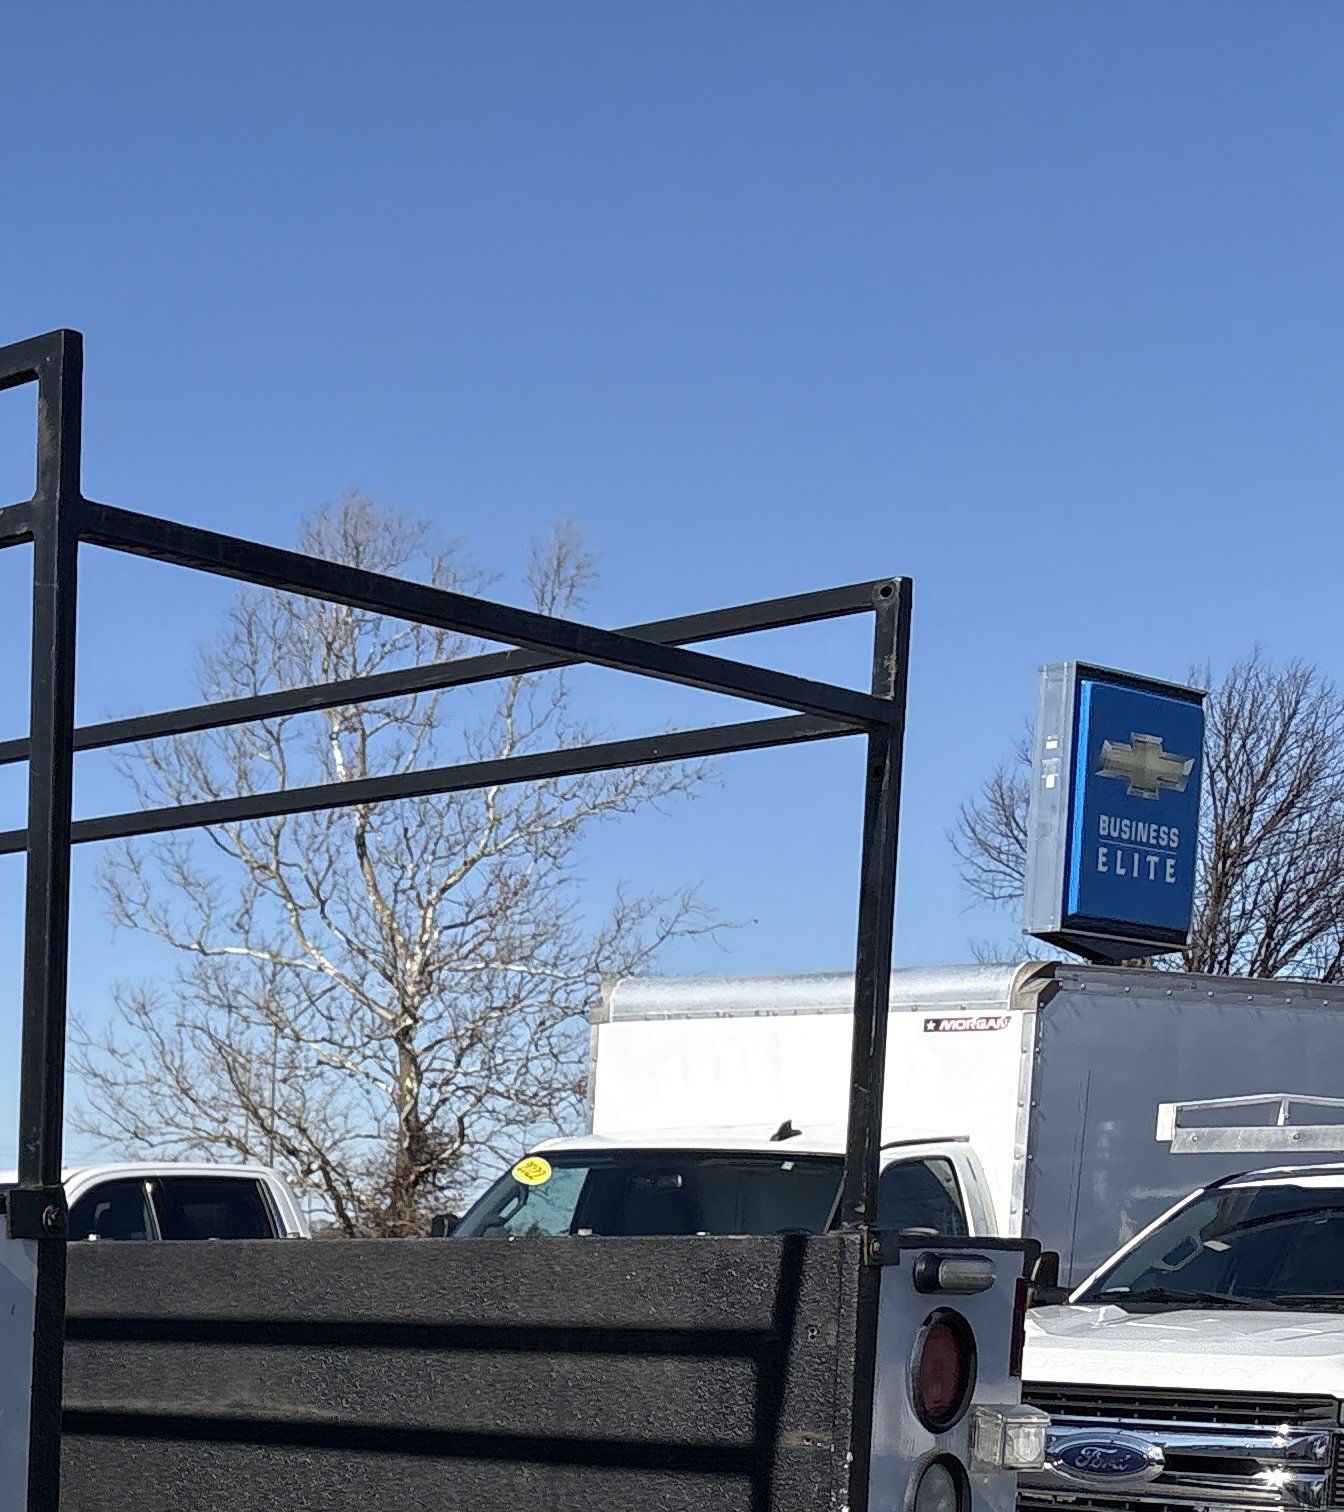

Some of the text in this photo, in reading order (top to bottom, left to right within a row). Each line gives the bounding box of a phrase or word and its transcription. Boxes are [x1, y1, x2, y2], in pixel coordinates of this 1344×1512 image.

[1099, 815, 1179, 848] BUSINESS
[1097, 847, 1177, 884] ELITE
[938, 1018, 1009, 1031] MORGAN
[1075, 1446, 1132, 1471] Ford
